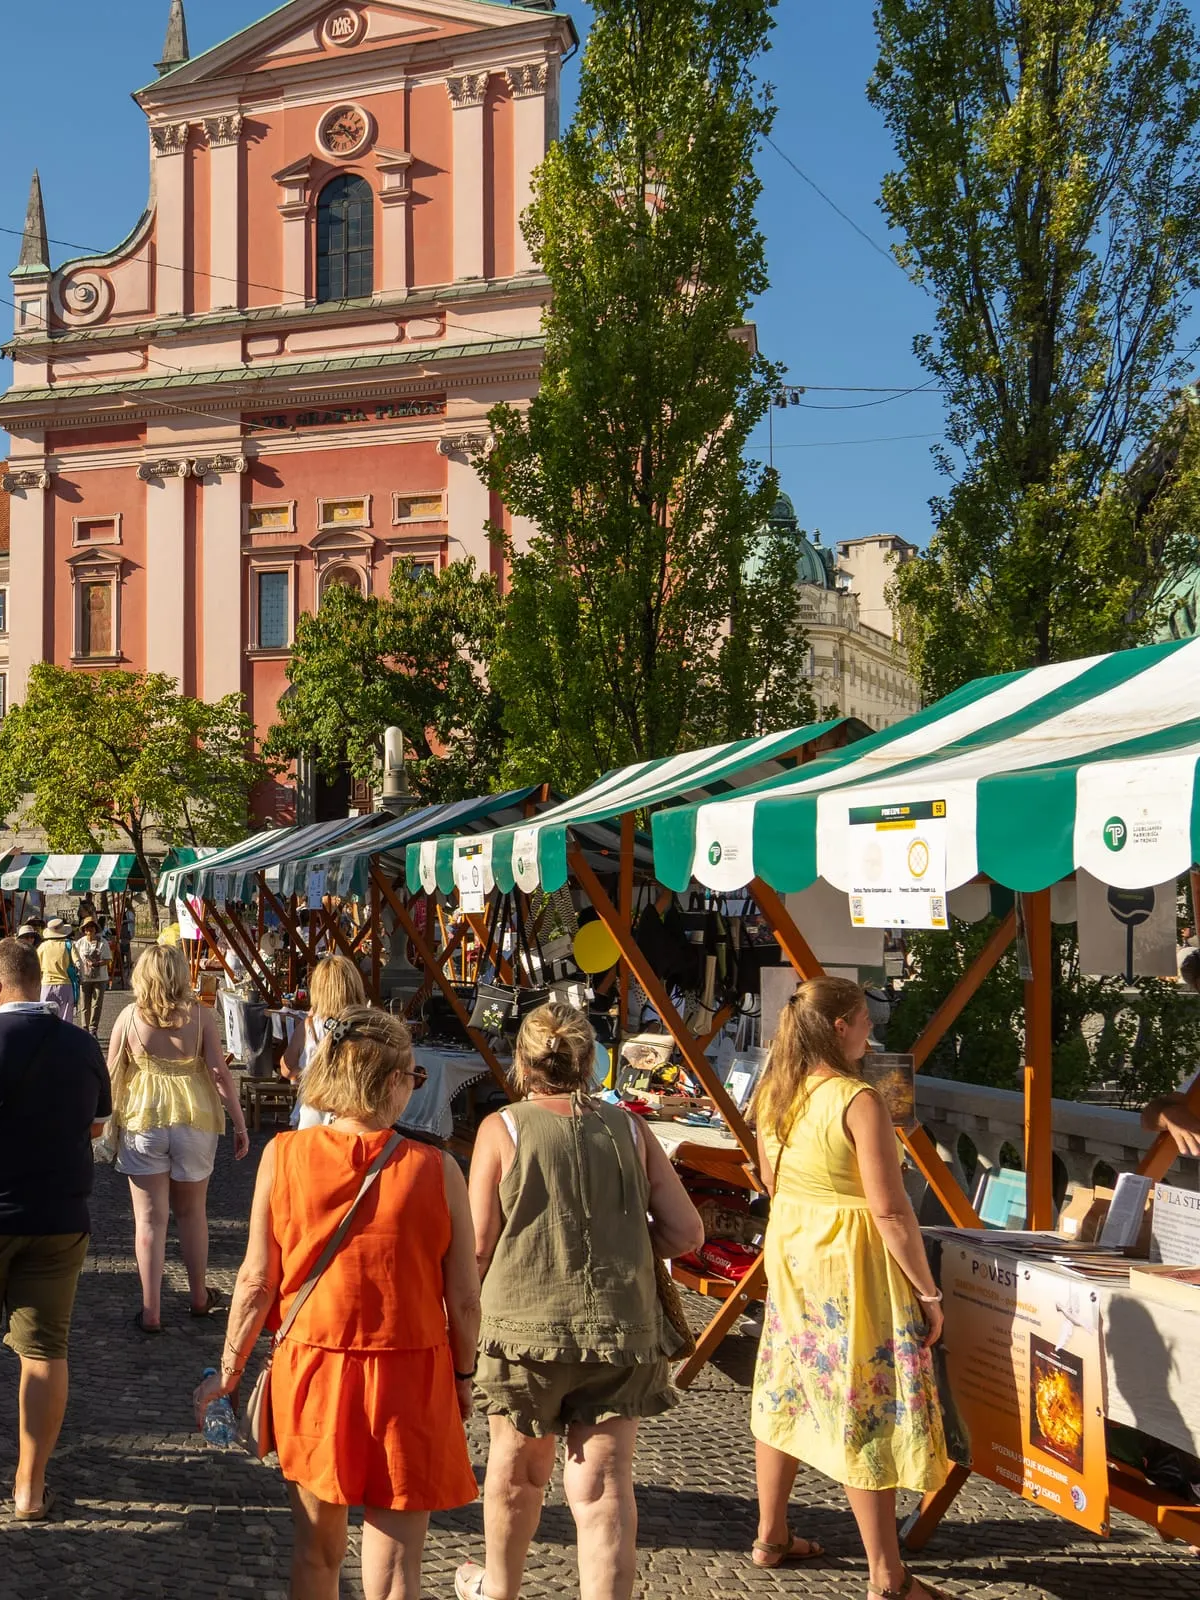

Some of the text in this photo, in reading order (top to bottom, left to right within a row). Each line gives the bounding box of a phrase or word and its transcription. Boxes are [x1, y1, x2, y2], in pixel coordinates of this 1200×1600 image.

[1156, 1187, 1181, 1206] ŠOLA
[972, 1260, 1019, 1289] POVEST
[992, 1442, 1018, 1463] SPOZNAJ
[1037, 1461, 1069, 1485] KORENINE
[995, 1465, 1021, 1484] PREBUDI
[1025, 1468, 1033, 1479] IN
